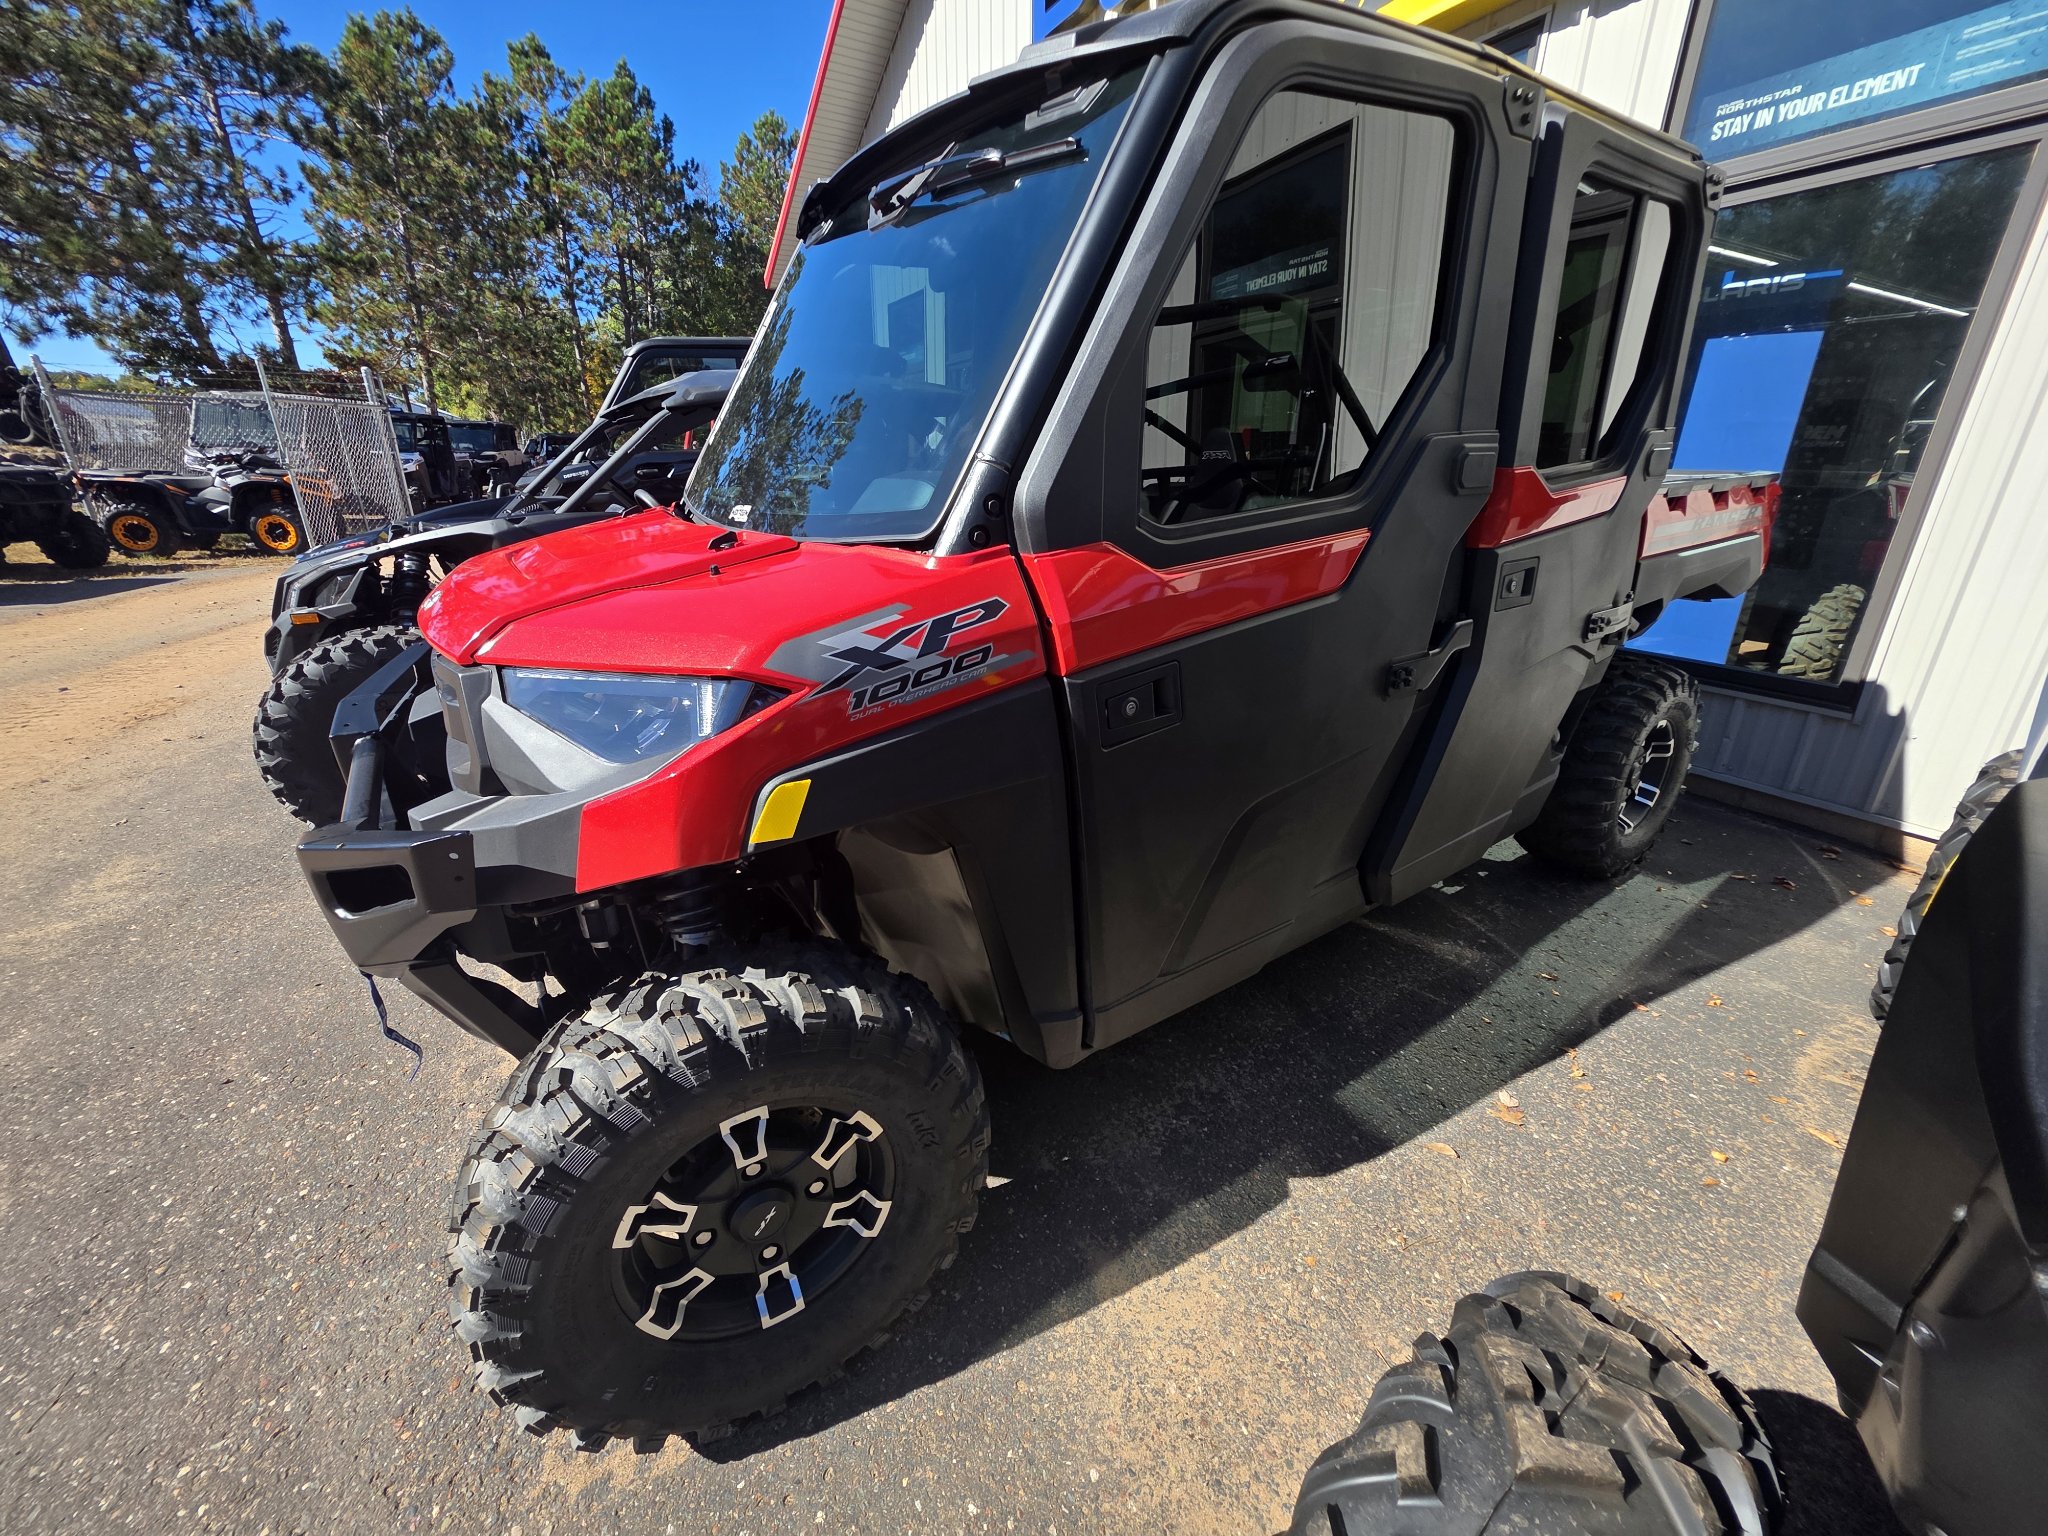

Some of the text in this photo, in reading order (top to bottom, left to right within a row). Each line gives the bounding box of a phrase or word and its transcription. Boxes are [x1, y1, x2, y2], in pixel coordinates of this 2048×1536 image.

[1710, 62, 1926, 142] STAY IN YOUR ELEMENT
[1715, 84, 1803, 118] NORTHSTAR
[797, 596, 1010, 703] XP
[848, 643, 993, 715] 1000
[850, 666, 988, 722] DUAL OVERHEAD CAM
